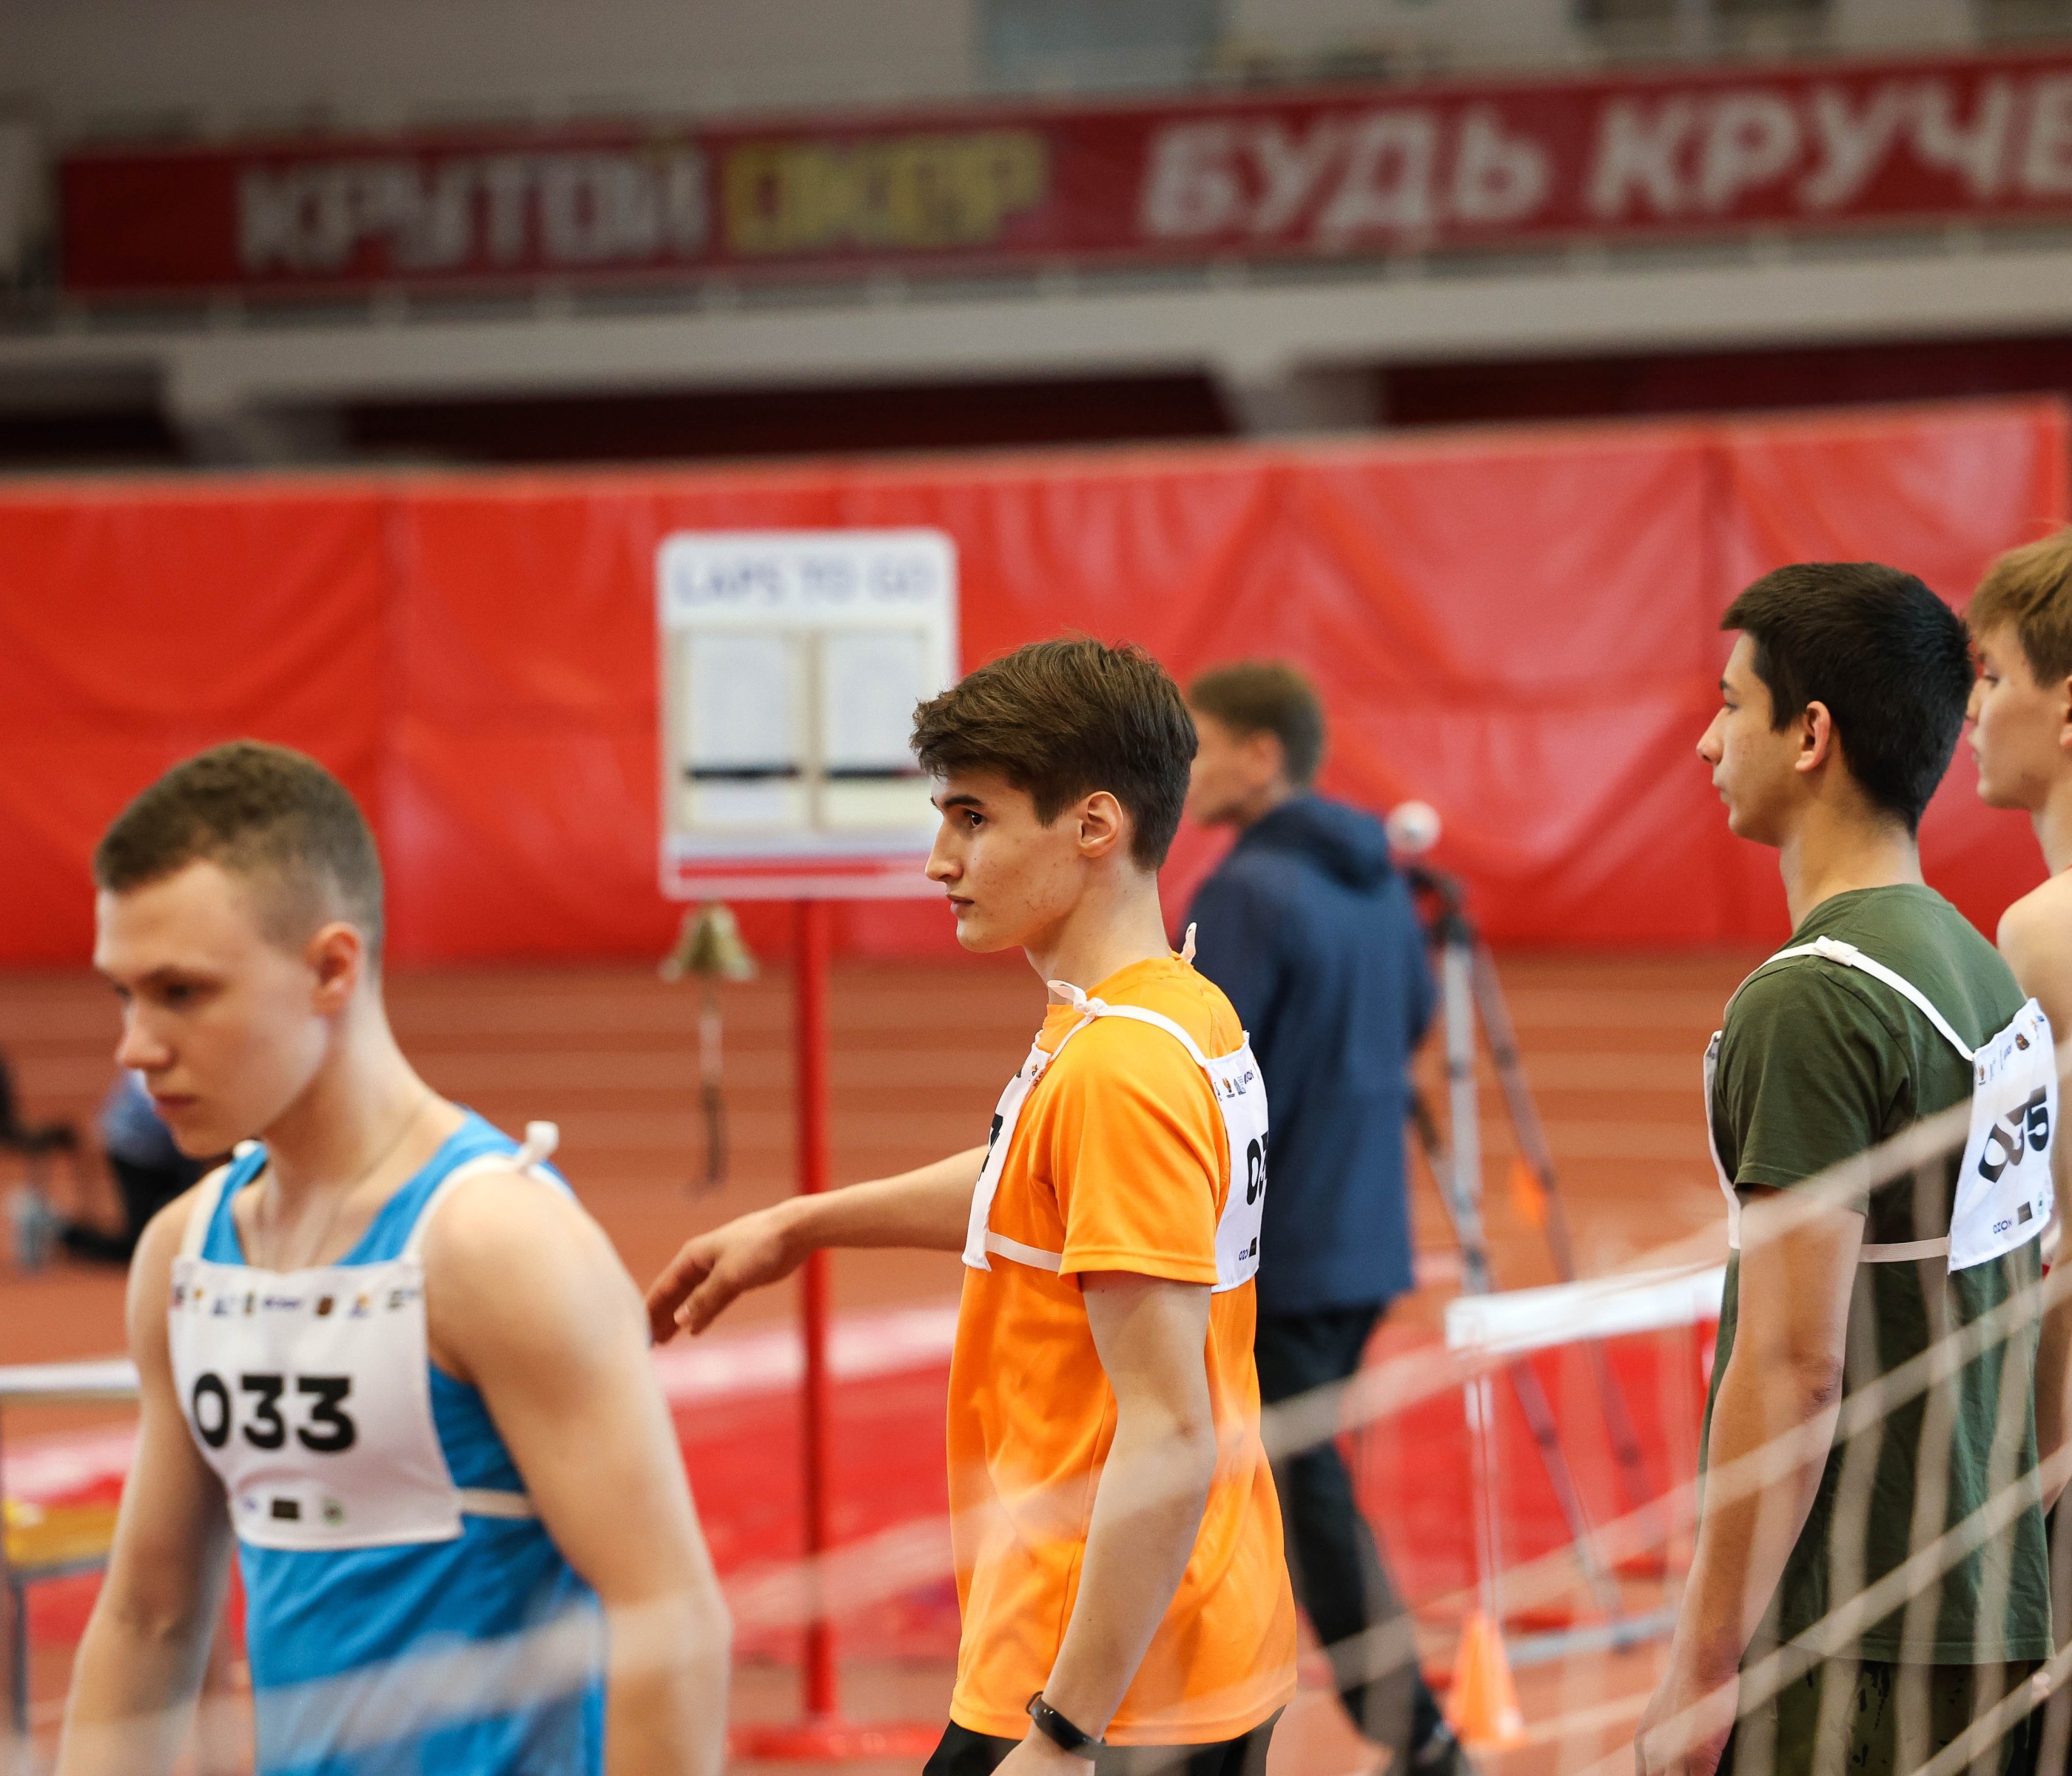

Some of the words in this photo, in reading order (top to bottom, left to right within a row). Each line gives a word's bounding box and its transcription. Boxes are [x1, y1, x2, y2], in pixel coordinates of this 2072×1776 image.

[1143, 107, 1550, 252] БУДЬ
[675, 559, 787, 605] LAPS
[796, 558, 856, 603] TO
[868, 555, 935, 601] GO
[192, 1373, 358, 1453] 033
